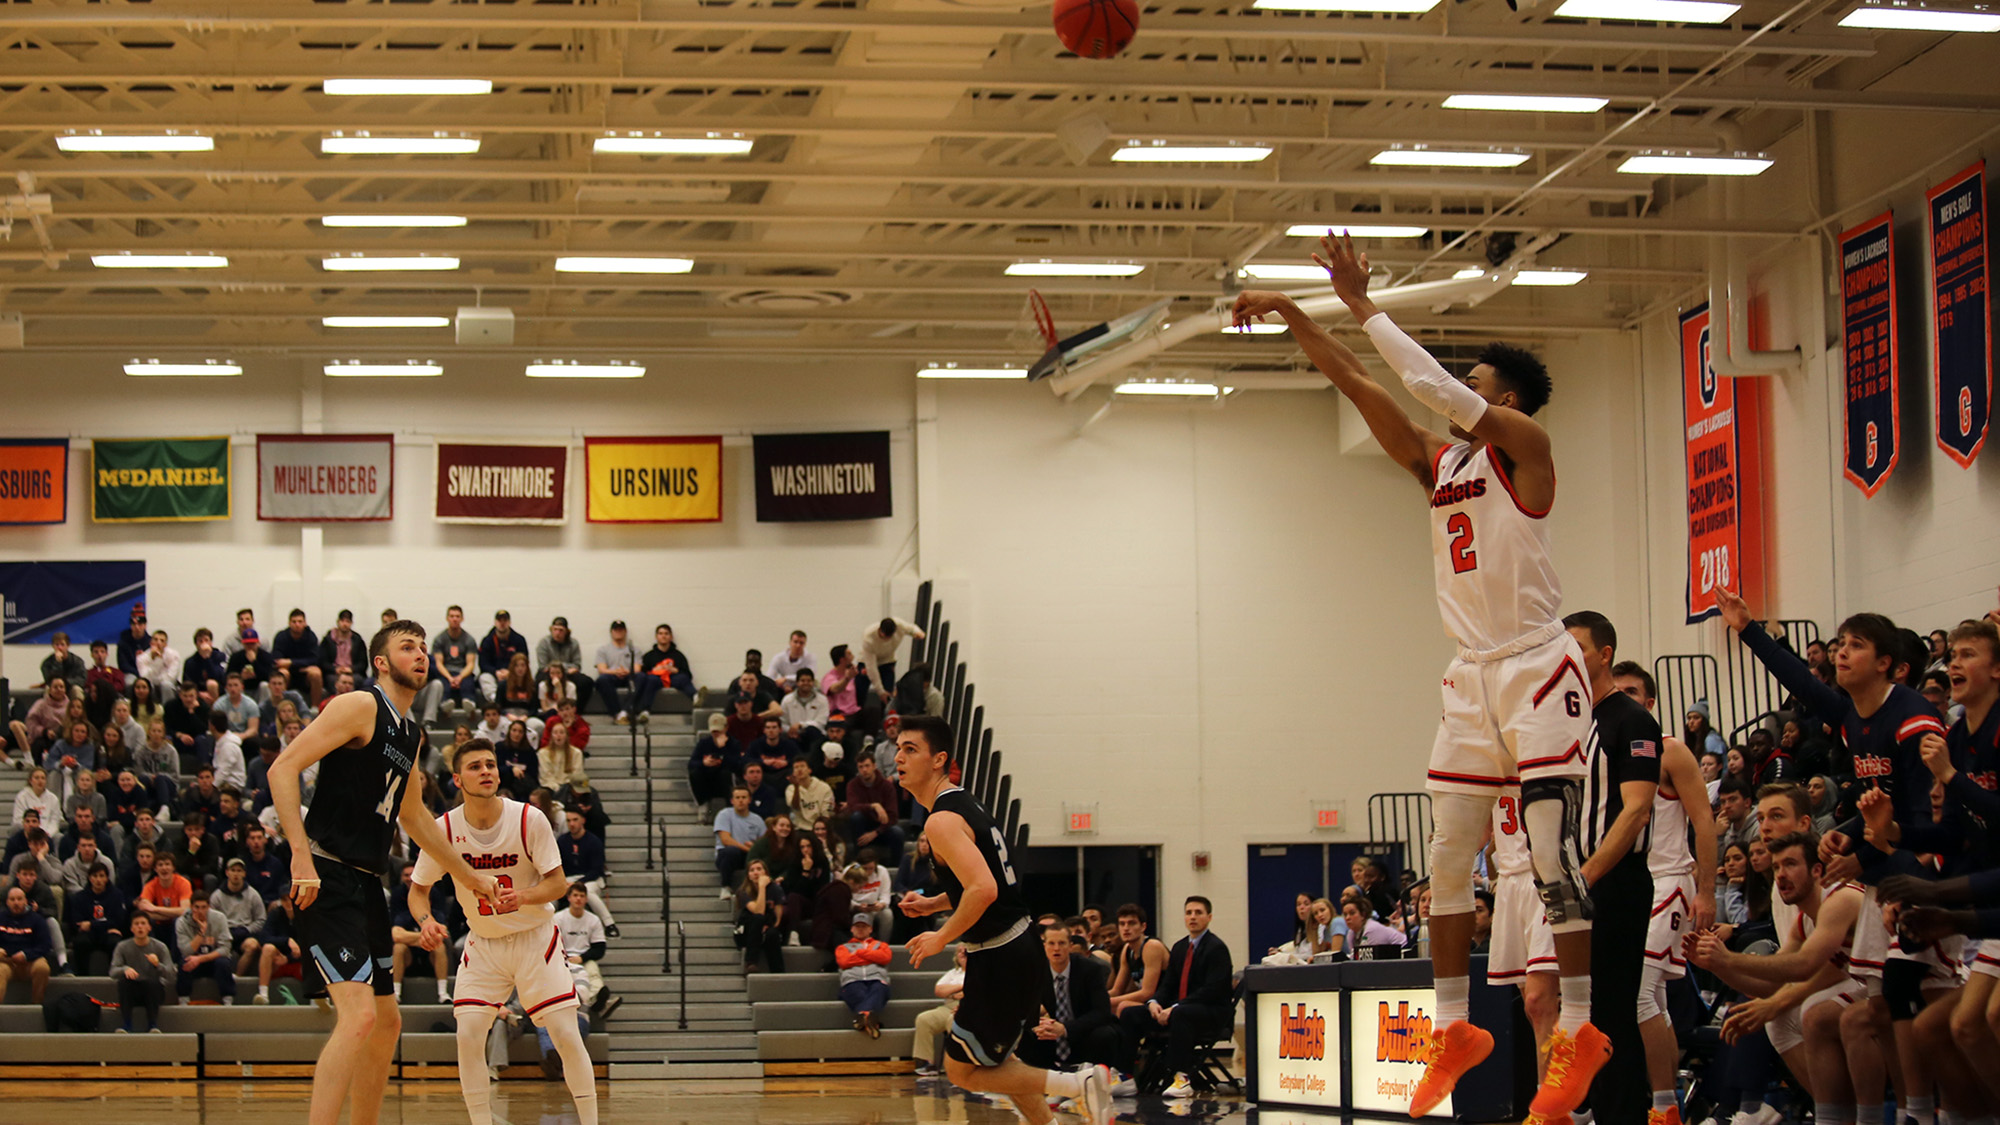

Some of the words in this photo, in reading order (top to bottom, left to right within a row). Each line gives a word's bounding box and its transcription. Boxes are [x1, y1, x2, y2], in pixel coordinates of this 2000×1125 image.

[1935, 211, 1982, 258] CHAMPIONS
[1846, 259, 1888, 298] CHAMPIONS
[1959, 385, 1972, 437] G
[1866, 420, 1878, 469] G
[1693, 442, 1729, 480] NATIONAL
[99, 467, 224, 488] McDANIEL
[273, 464, 378, 495] MUHLENBERG
[448, 465, 555, 497] SWARTHMORE
[610, 467, 699, 496] URSINUS
[771, 463, 876, 495] WASHINGTON
[1689, 473, 1734, 514] CHAMPIONS
[1447, 511, 1477, 575] 2
[1700, 544, 1730, 595] 2018
[1564, 690, 1582, 718] G
[383, 742, 412, 774] HOPKINS
[1071, 812, 1092, 830] EXIT
[1318, 810, 1339, 827] EXIT
[462, 852, 519, 870] Bullets
[1670, 911, 1681, 931] G
[1279, 1002, 1326, 1061] Bullets
[1279, 1072, 1305, 1094] Gettysburg
[1306, 1074, 1326, 1096] College
[1377, 1077, 1407, 1101] Gettysburg
